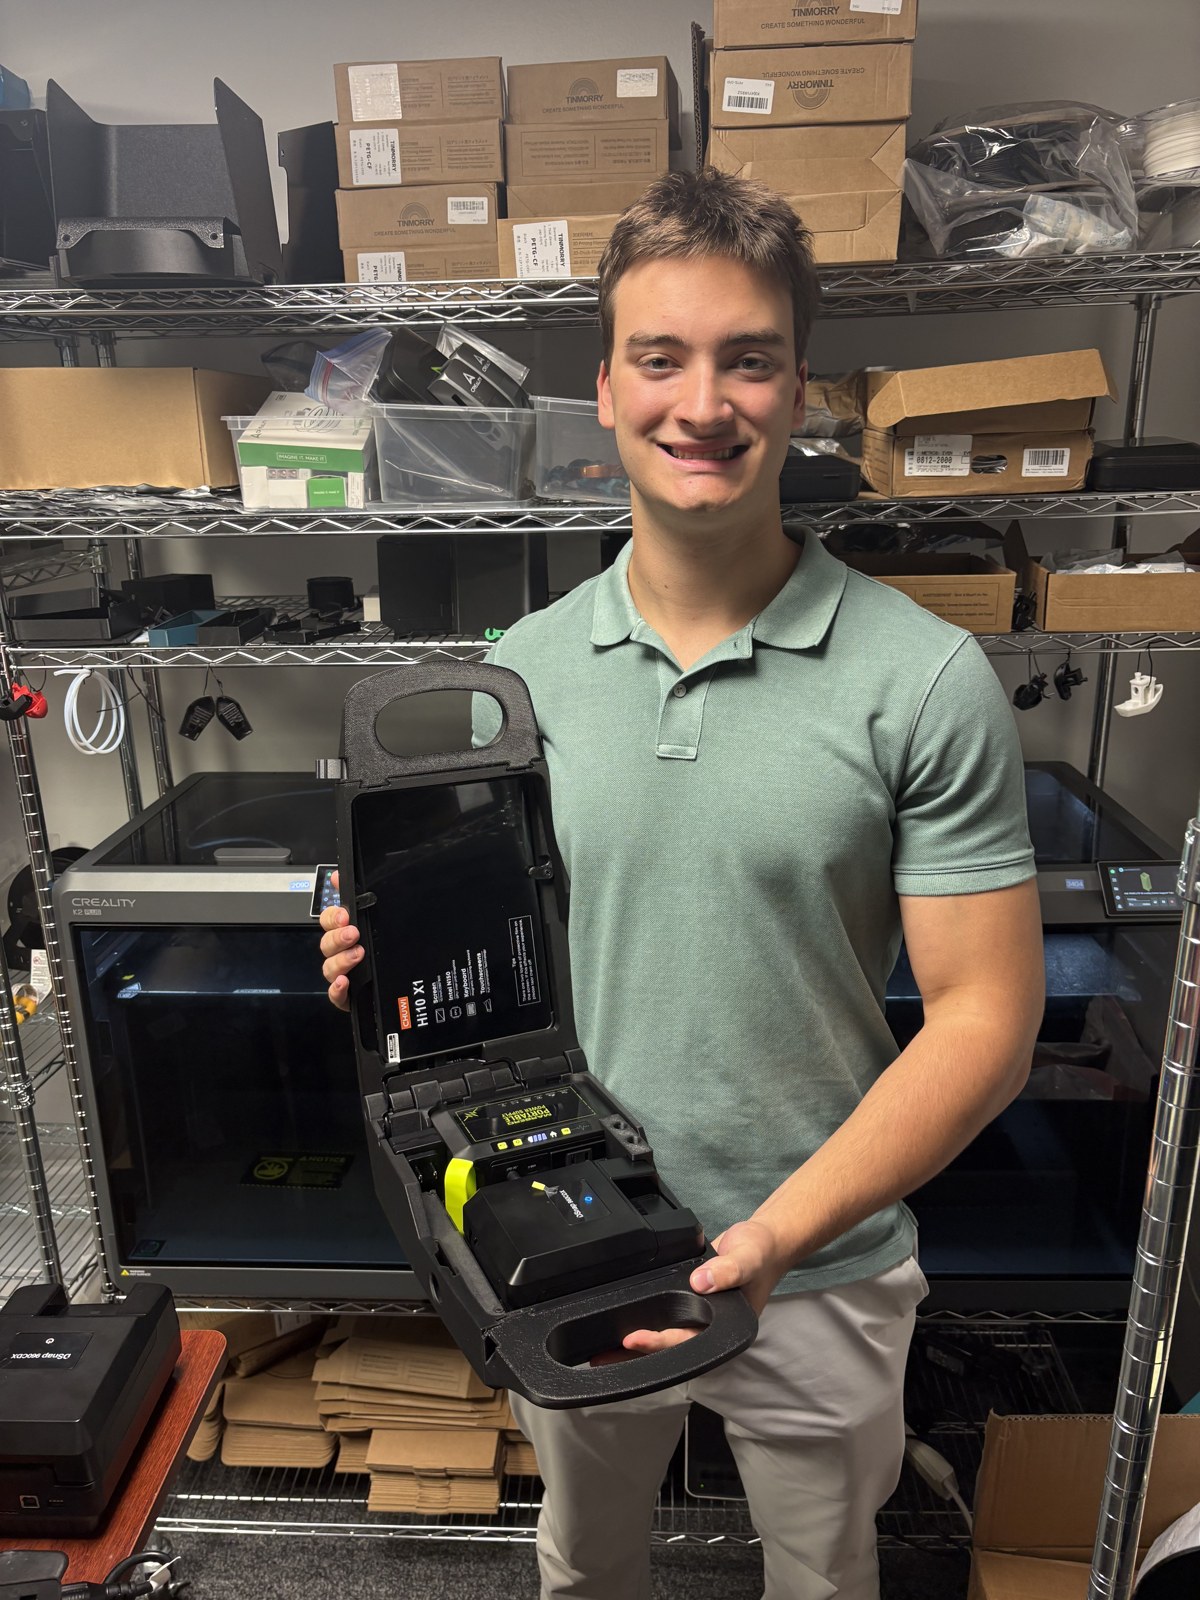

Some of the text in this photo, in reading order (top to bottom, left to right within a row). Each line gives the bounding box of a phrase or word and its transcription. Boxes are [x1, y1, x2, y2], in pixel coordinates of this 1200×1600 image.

[792, 6, 840, 17] TINMORRY
[761, 18, 865, 30] CREATE SOMETHING WONDERFUL
[787, 79, 834, 89] TINMORRY
[566, 95, 604, 103] TINMORRY
[397, 219, 435, 227] TINMORRY
[72, 898, 136, 907] CREALITY
[476, 952, 486, 994] Touchscreens
[461, 968, 470, 998] Keyboard
[412, 979, 429, 1027] Hi10 X1
[401, 999, 410, 1027] CHUWI
[501, 1108, 523, 1117] SUPPLY
[503, 1108, 550, 1122] PORTABLE
